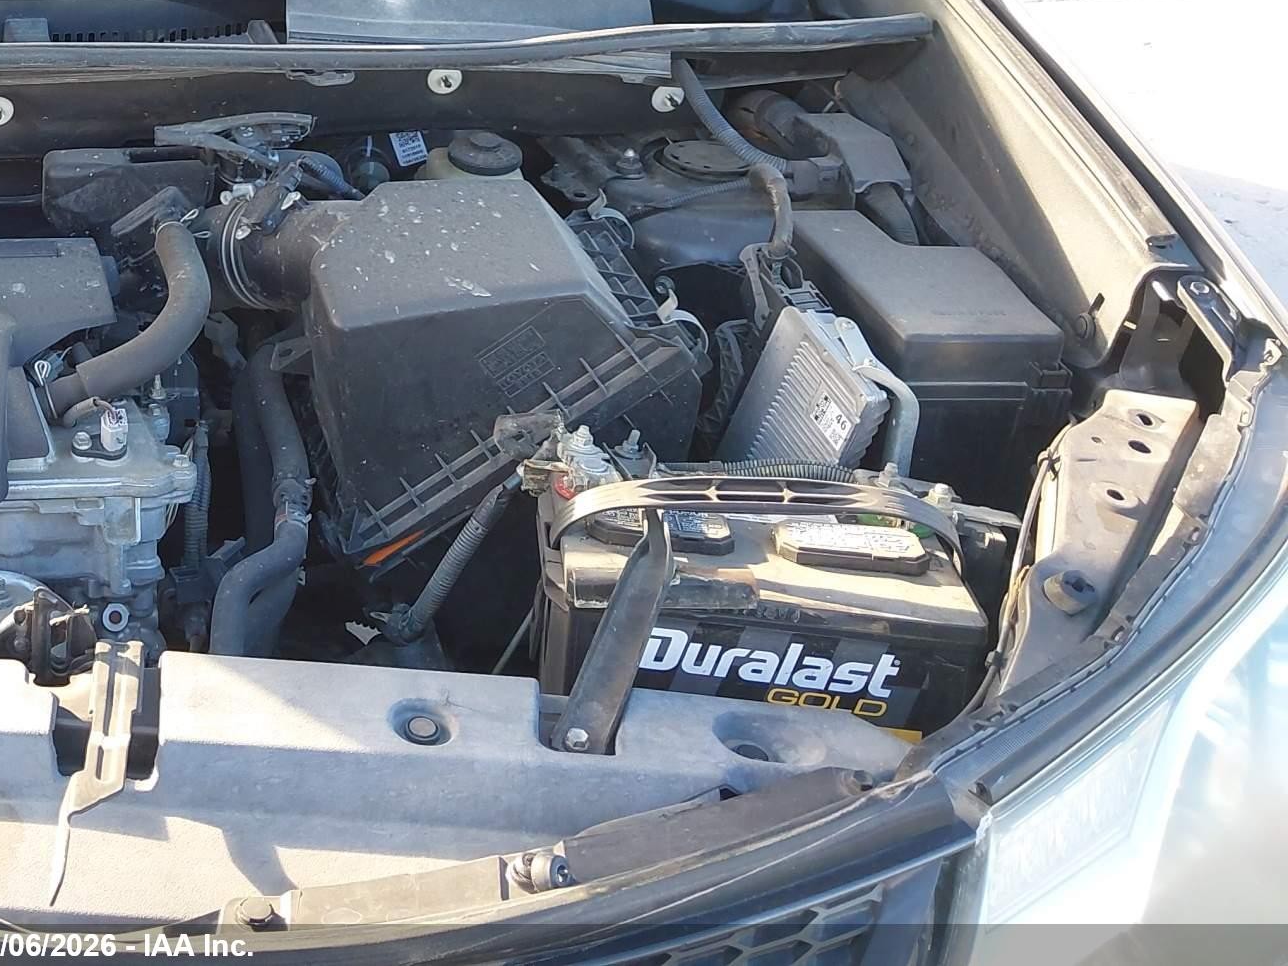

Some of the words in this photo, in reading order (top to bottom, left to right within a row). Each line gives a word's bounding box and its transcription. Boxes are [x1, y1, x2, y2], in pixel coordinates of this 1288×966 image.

[835, 414, 848, 431] 46
[638, 626, 900, 698] Duralast
[767, 688, 888, 717] GOLD
